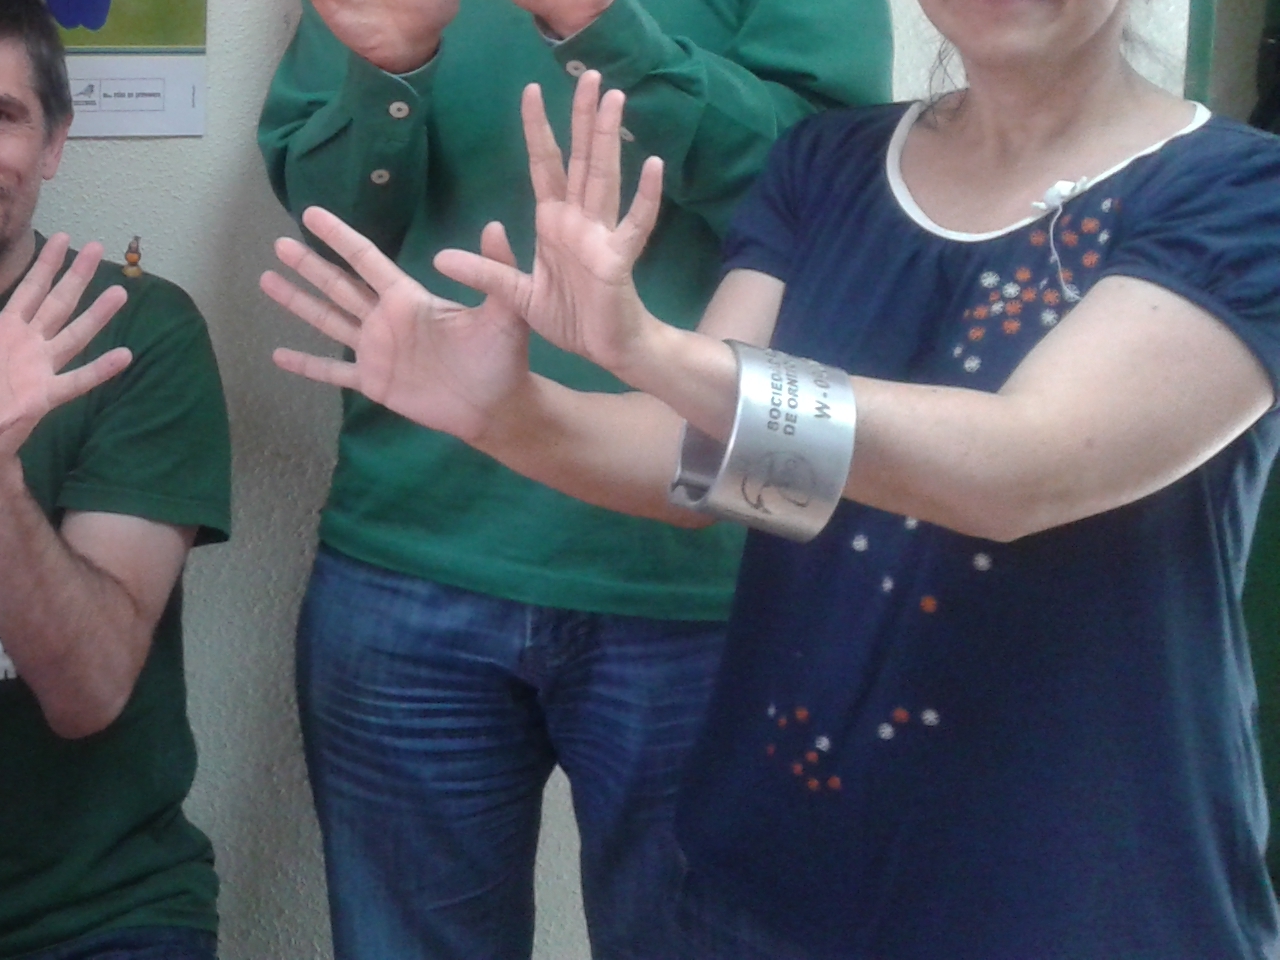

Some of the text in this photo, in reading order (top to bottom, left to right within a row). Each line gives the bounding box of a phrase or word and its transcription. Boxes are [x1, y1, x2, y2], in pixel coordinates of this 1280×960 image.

[767, 353, 783, 431] SOCIED
[783, 366, 799, 436] DE ORNI
